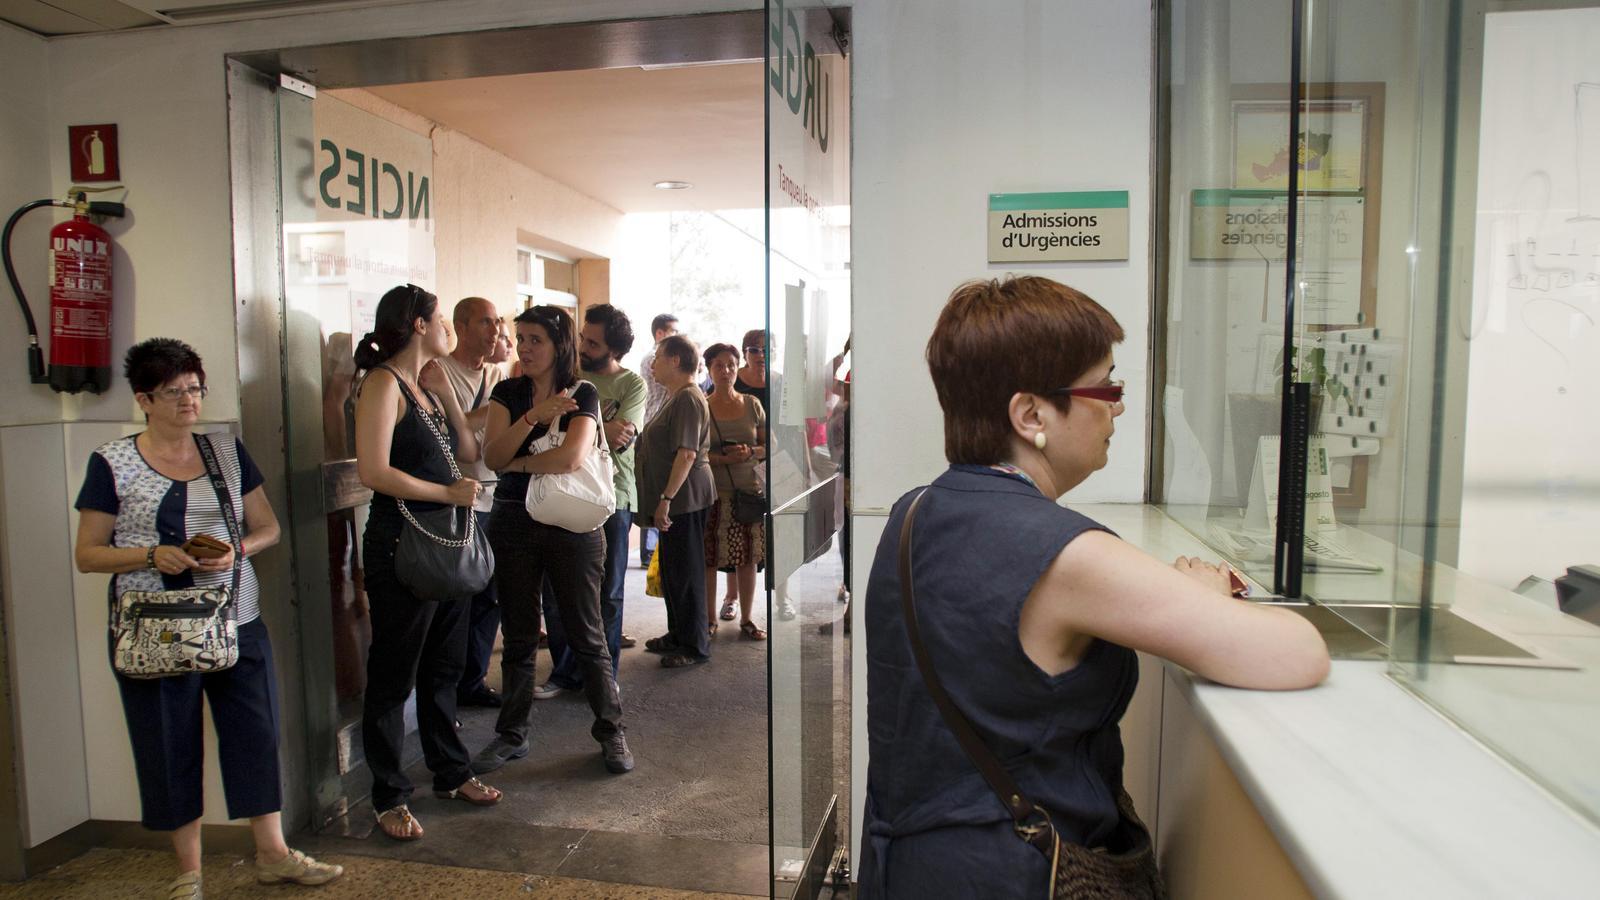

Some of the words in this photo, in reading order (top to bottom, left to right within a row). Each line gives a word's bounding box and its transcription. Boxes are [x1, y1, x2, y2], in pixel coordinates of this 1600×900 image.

[1002, 212, 1097, 228] Admissions
[54, 237, 108, 256] UNIX
[1002, 232, 1100, 251] d'Urgències
